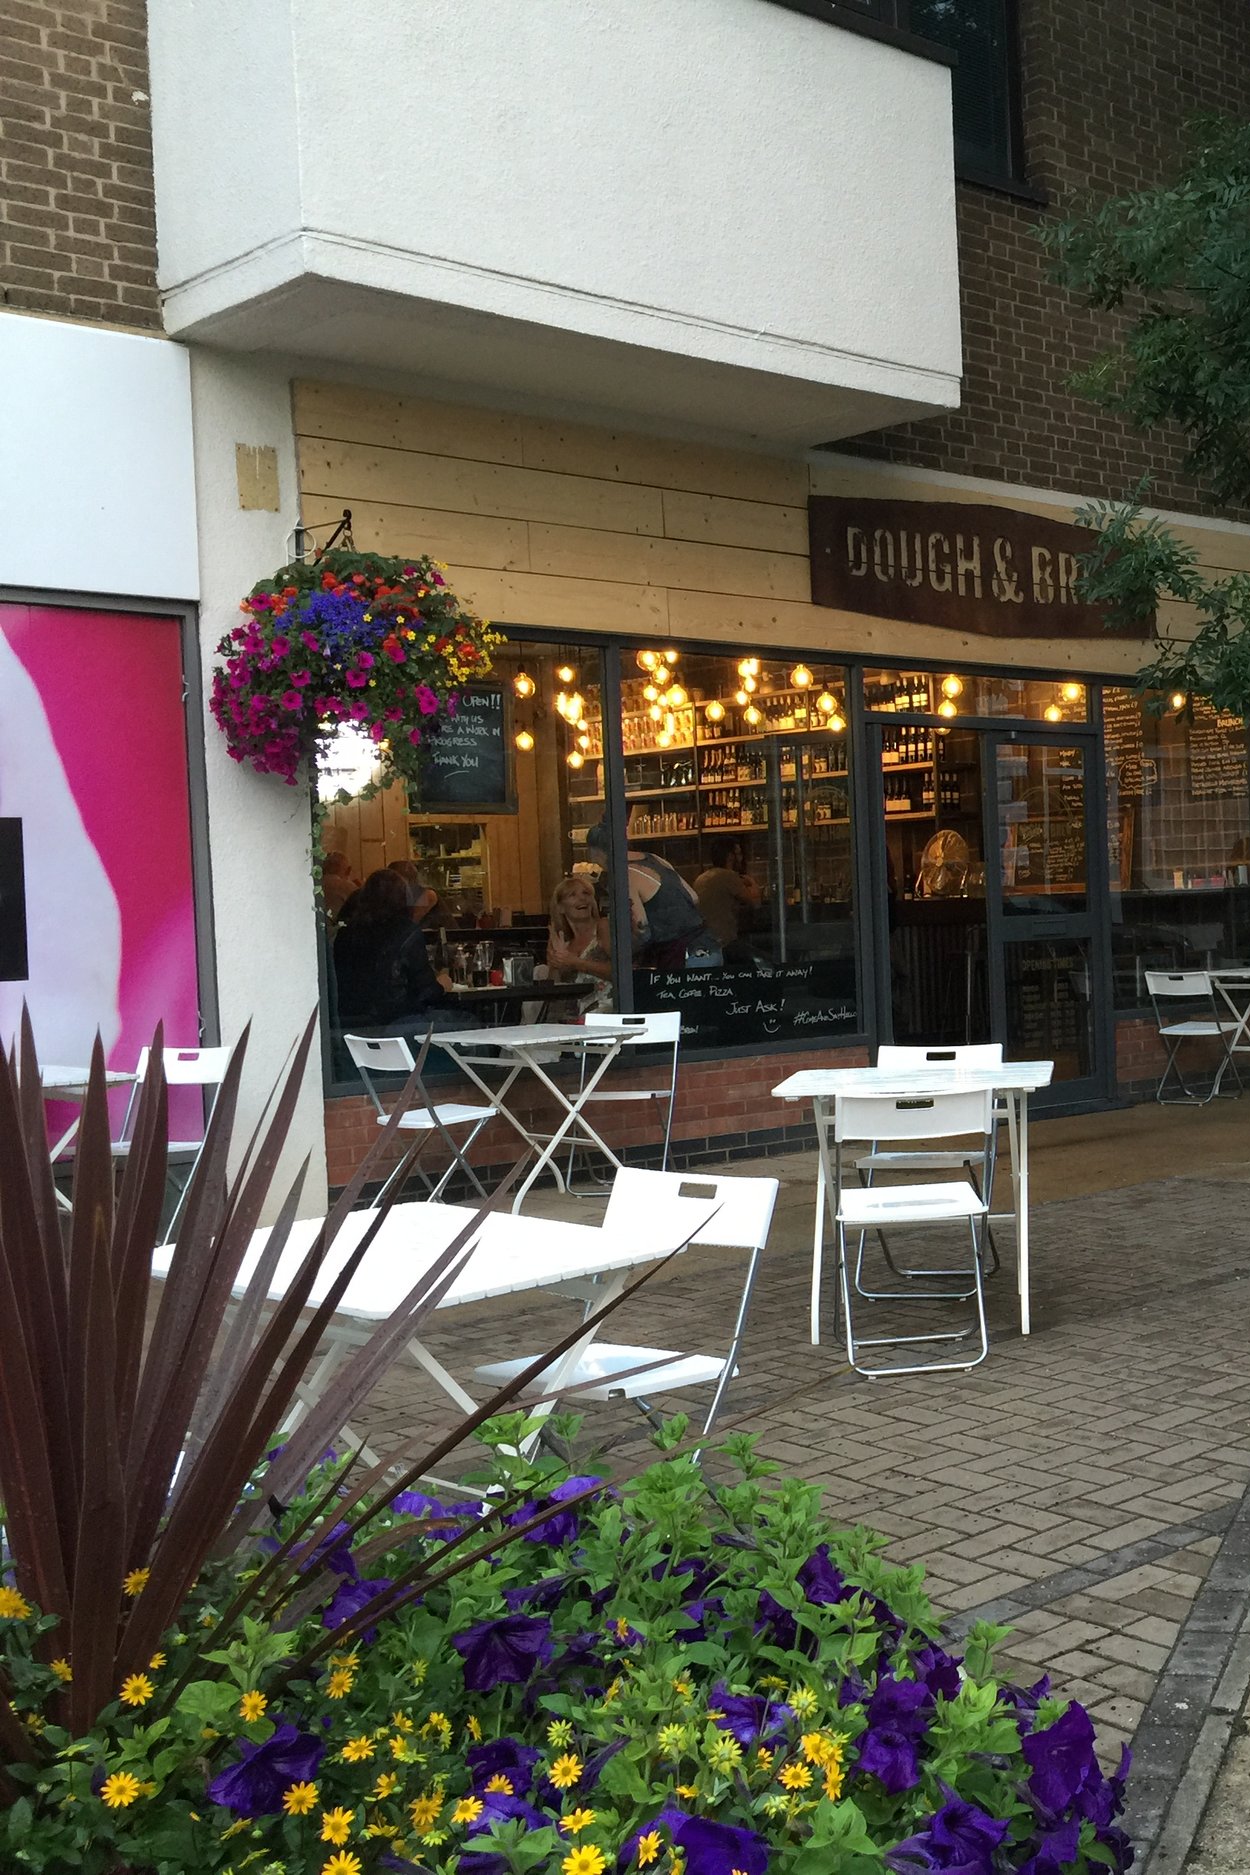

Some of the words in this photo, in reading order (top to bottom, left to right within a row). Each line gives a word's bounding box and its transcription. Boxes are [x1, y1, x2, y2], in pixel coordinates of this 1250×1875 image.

[847, 526, 982, 599] DOUGH
[991, 537, 1024, 604] &
[1031, 546, 1121, 605] BR
[461, 754, 479, 767] YOU
[650, 973, 660, 985] IF
[666, 973, 681, 985] YOU
[722, 972, 735, 980] YOU
[785, 965, 813, 979] AWAY!
[725, 1001, 751, 1016] JUST
